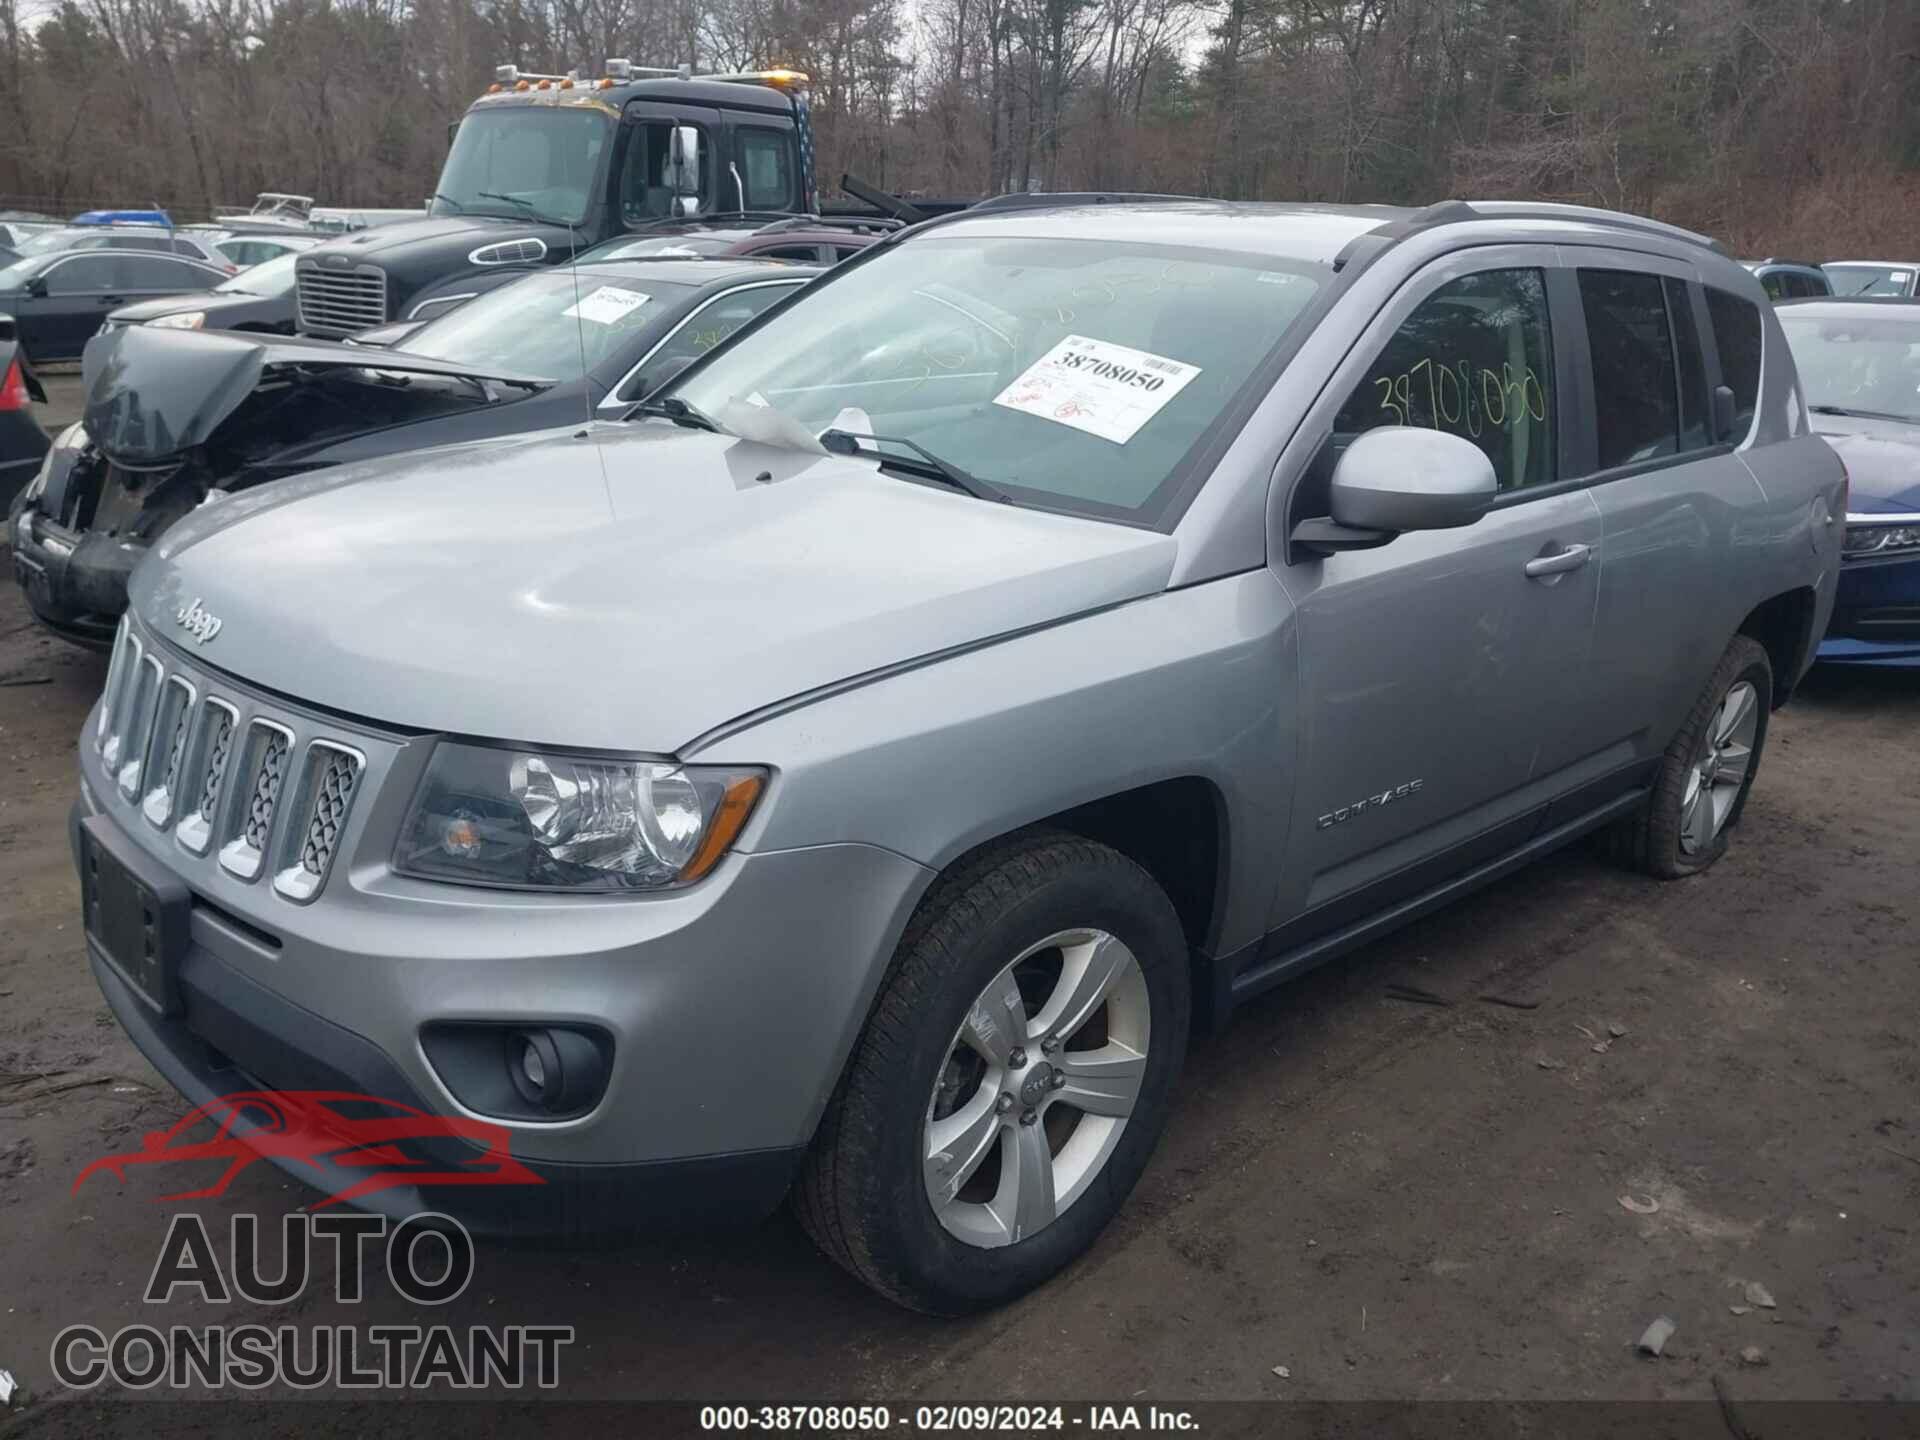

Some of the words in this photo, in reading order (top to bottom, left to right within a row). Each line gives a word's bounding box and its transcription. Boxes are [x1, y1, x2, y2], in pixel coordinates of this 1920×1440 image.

[1053, 351, 1165, 392] 38708050
[176, 598, 222, 645] Jeep
[1317, 778, 1423, 830] COMPASS
